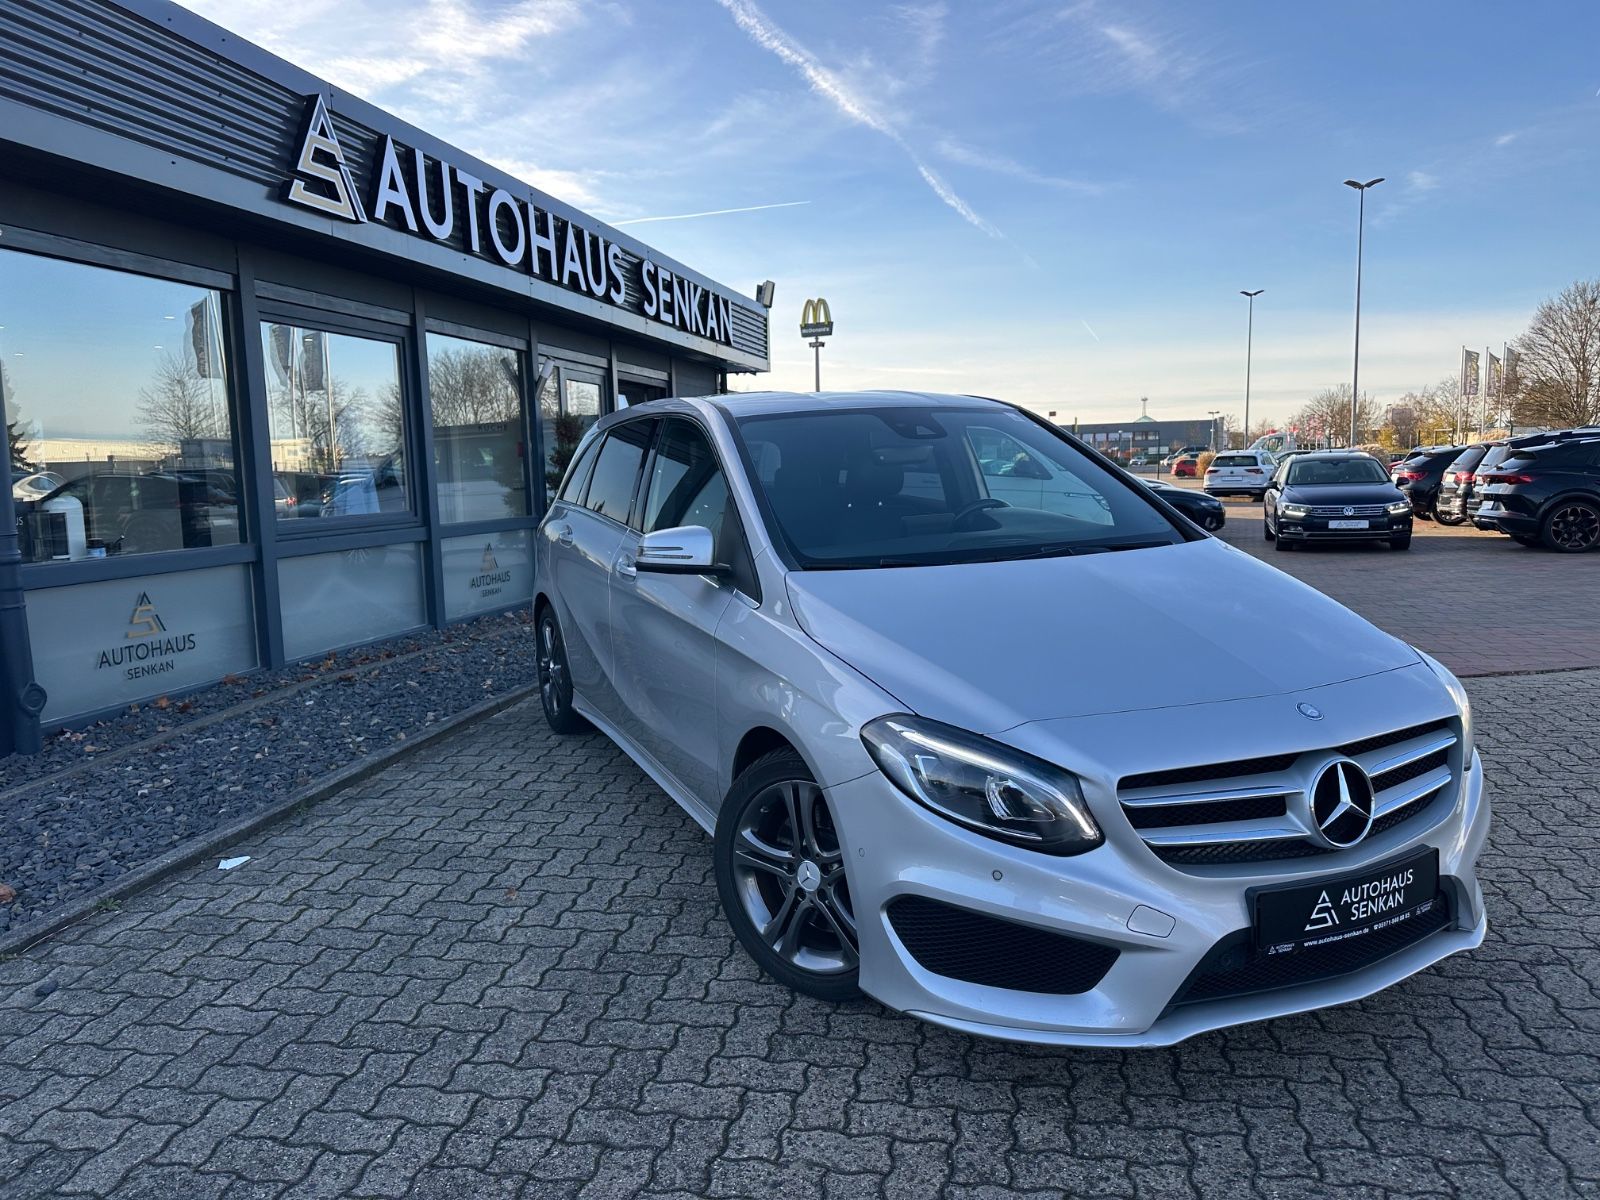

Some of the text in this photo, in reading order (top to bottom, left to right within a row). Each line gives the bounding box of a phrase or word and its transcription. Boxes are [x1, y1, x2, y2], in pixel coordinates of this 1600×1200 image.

[374, 133, 626, 305] AUTOHAUS
[641, 259, 734, 347] SENKAN
[470, 570, 511, 589] AUTOHAUS
[98, 633, 197, 670] AUTOHAUS
[126, 659, 175, 681] SENKAN
[1340, 868, 1414, 906] AUTOHAUS
[1350, 889, 1404, 921] SENKAN
[1303, 927, 1370, 948] www.autohaus-senkan.de
